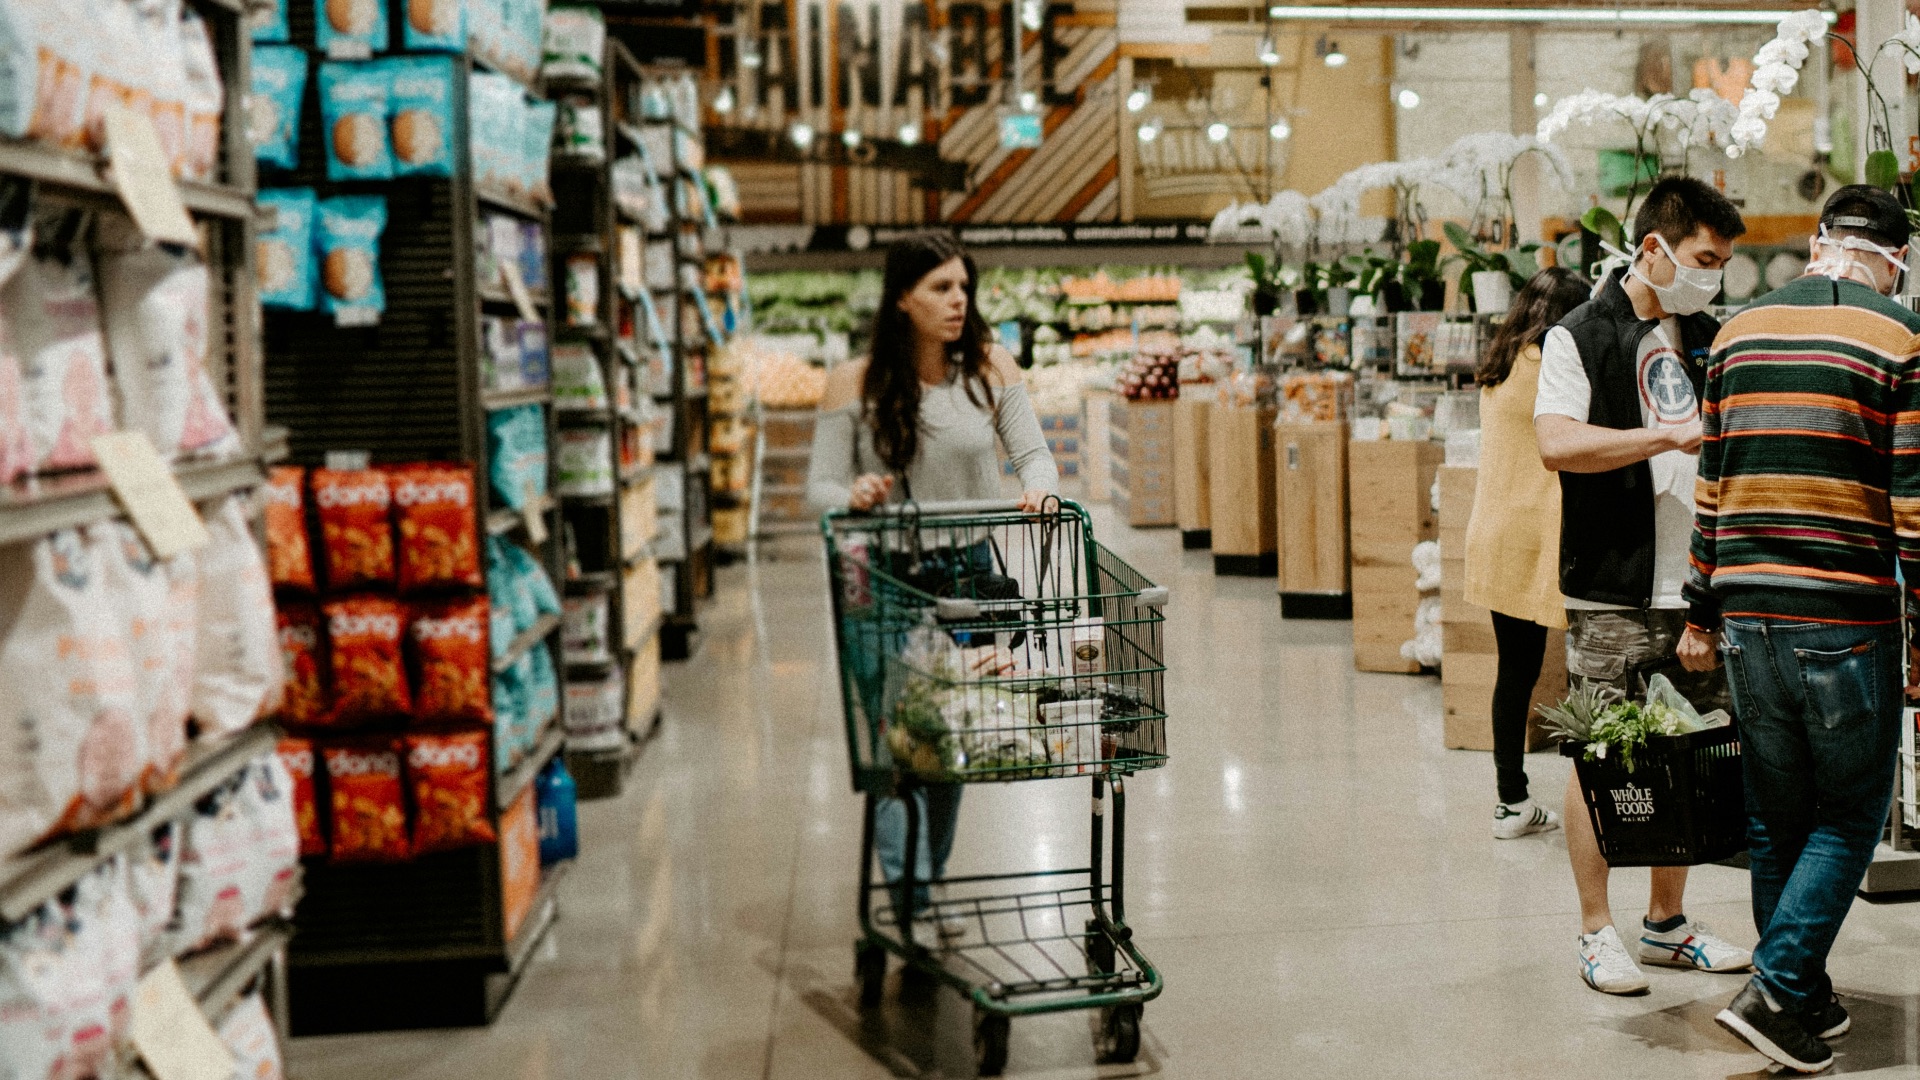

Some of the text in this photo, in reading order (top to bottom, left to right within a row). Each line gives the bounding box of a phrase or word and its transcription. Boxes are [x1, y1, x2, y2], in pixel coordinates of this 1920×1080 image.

[317, 482, 391, 511] dang
[396, 481, 468, 510] dang
[328, 613, 399, 641] dang
[412, 616, 481, 644] dang
[327, 750, 400, 779] dang
[408, 742, 481, 771] dang
[1610, 788, 1653, 801] WHOLE
[1615, 801, 1655, 815] FOODS
